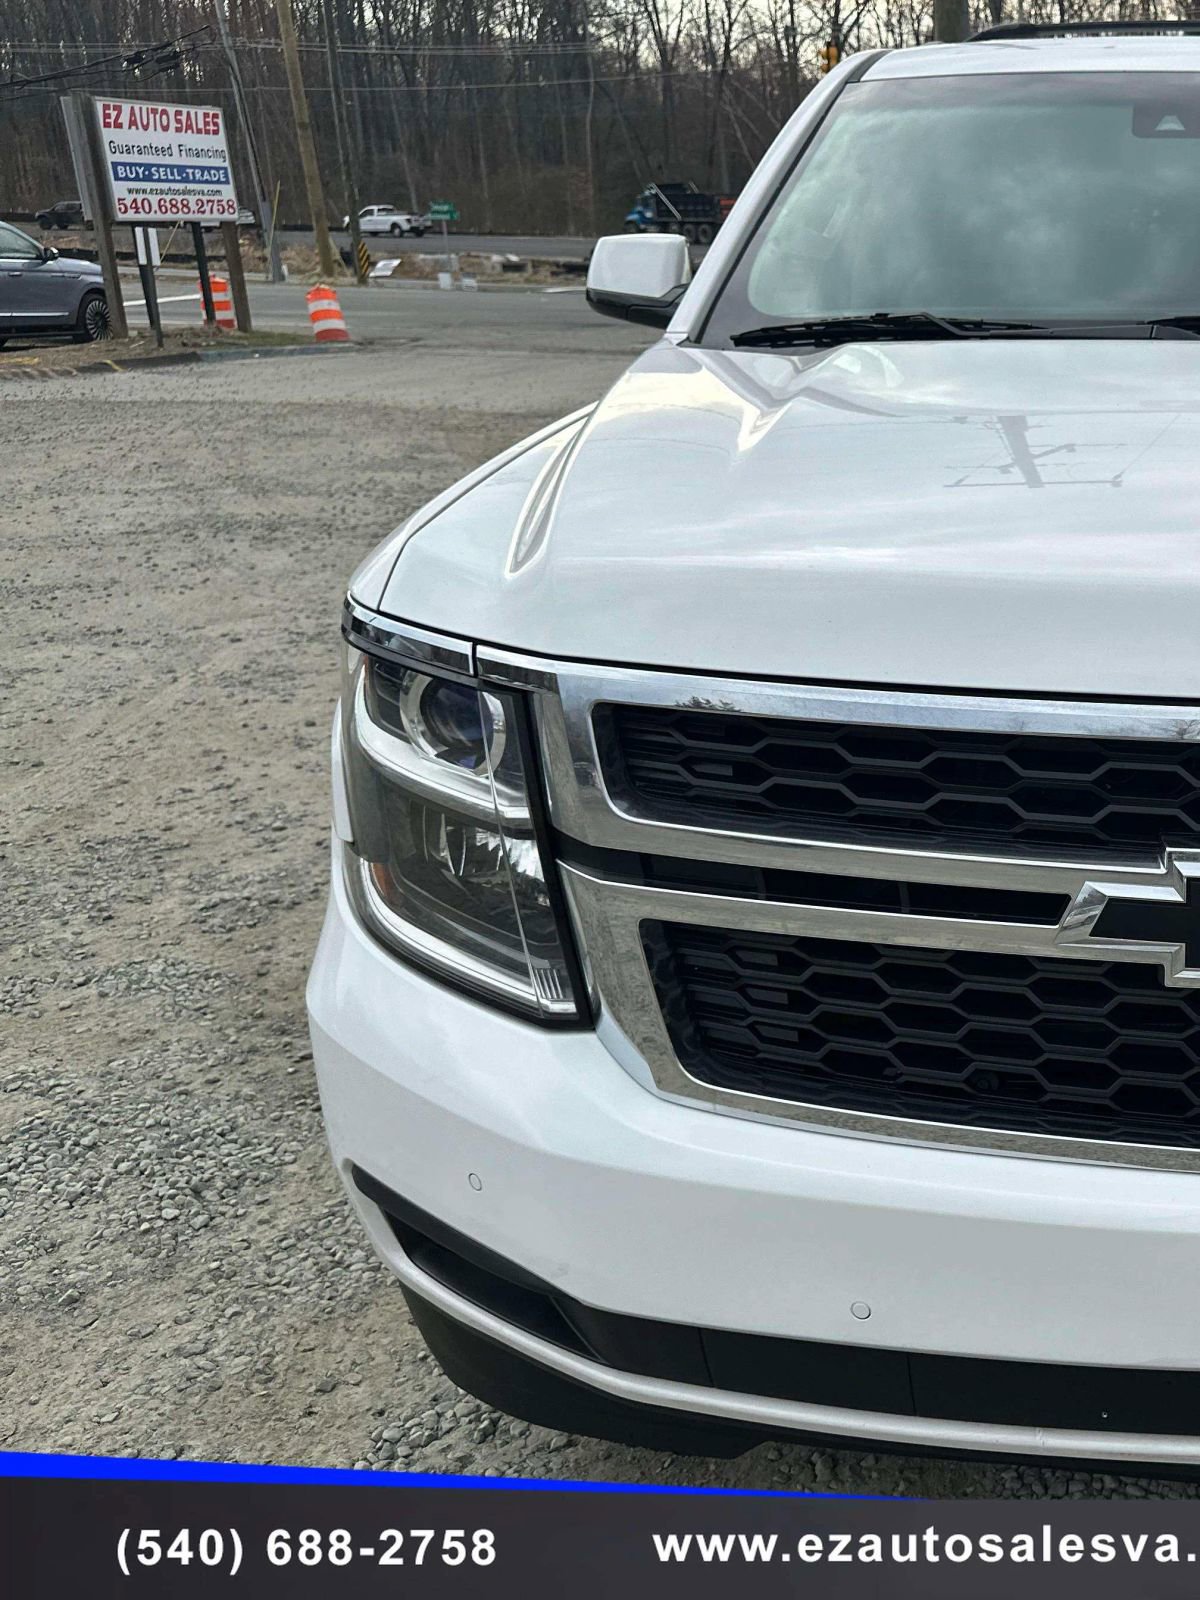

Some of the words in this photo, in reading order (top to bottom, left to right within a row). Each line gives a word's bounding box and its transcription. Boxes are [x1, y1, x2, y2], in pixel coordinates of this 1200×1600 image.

[102, 103, 123, 129] EZ
[128, 106, 170, 132] AUTO
[174, 109, 220, 136] SALES
[109, 140, 173, 157] Guaranteed
[178, 143, 227, 163] Financing
[127, 185, 222, 196] www.ezautosalesva.com
[117, 197, 236, 215] 540.688.2758
